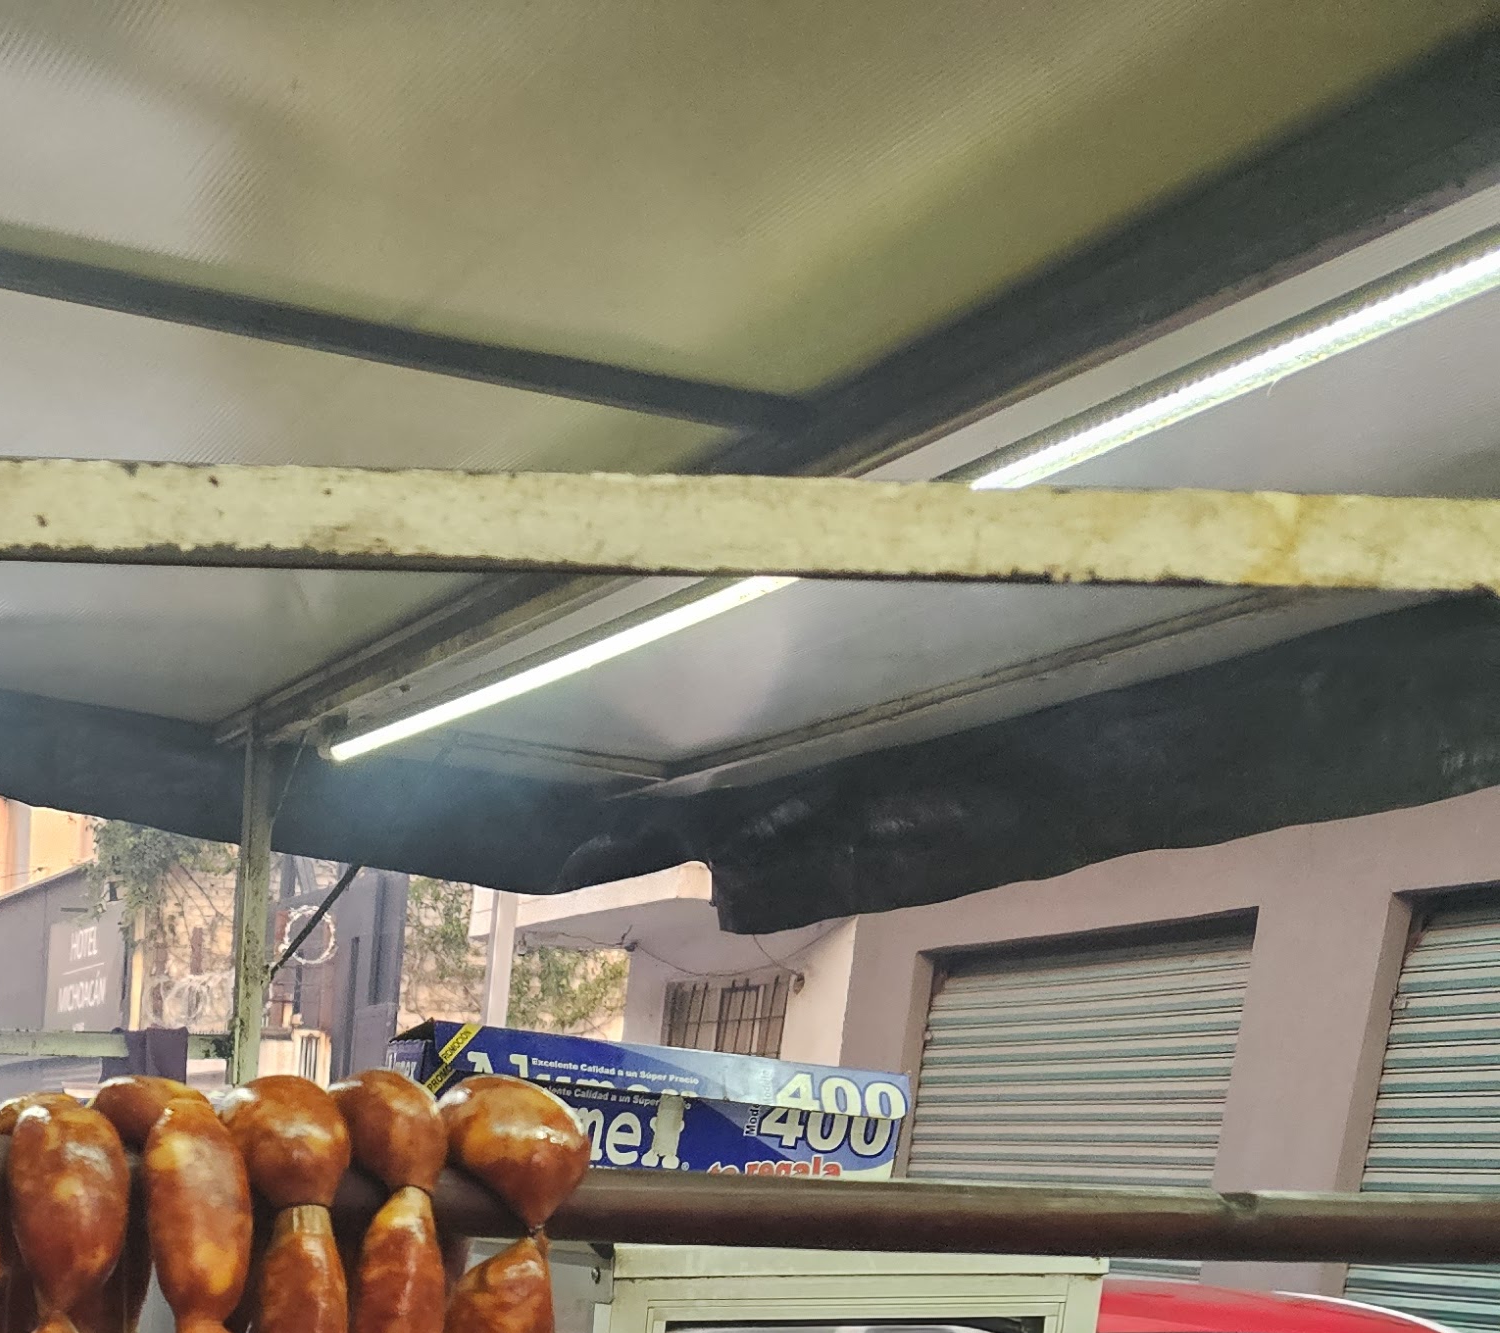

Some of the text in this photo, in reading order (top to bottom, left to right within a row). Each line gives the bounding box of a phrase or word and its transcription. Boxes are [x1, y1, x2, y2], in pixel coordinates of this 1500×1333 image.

[70, 926, 98, 961] HOTEL
[531, 1057, 579, 1071] Excelente
[580, 1063, 616, 1076] Calidad
[625, 1070, 638, 1078] un
[639, 1070, 667, 1082] Súper
[669, 1074, 699, 1085] Precio
[574, 1088, 609, 1101] Calidad
[618, 1095, 630, 1103] un
[775, 1072, 907, 1120] 400
[758, 1107, 896, 1158] 400
